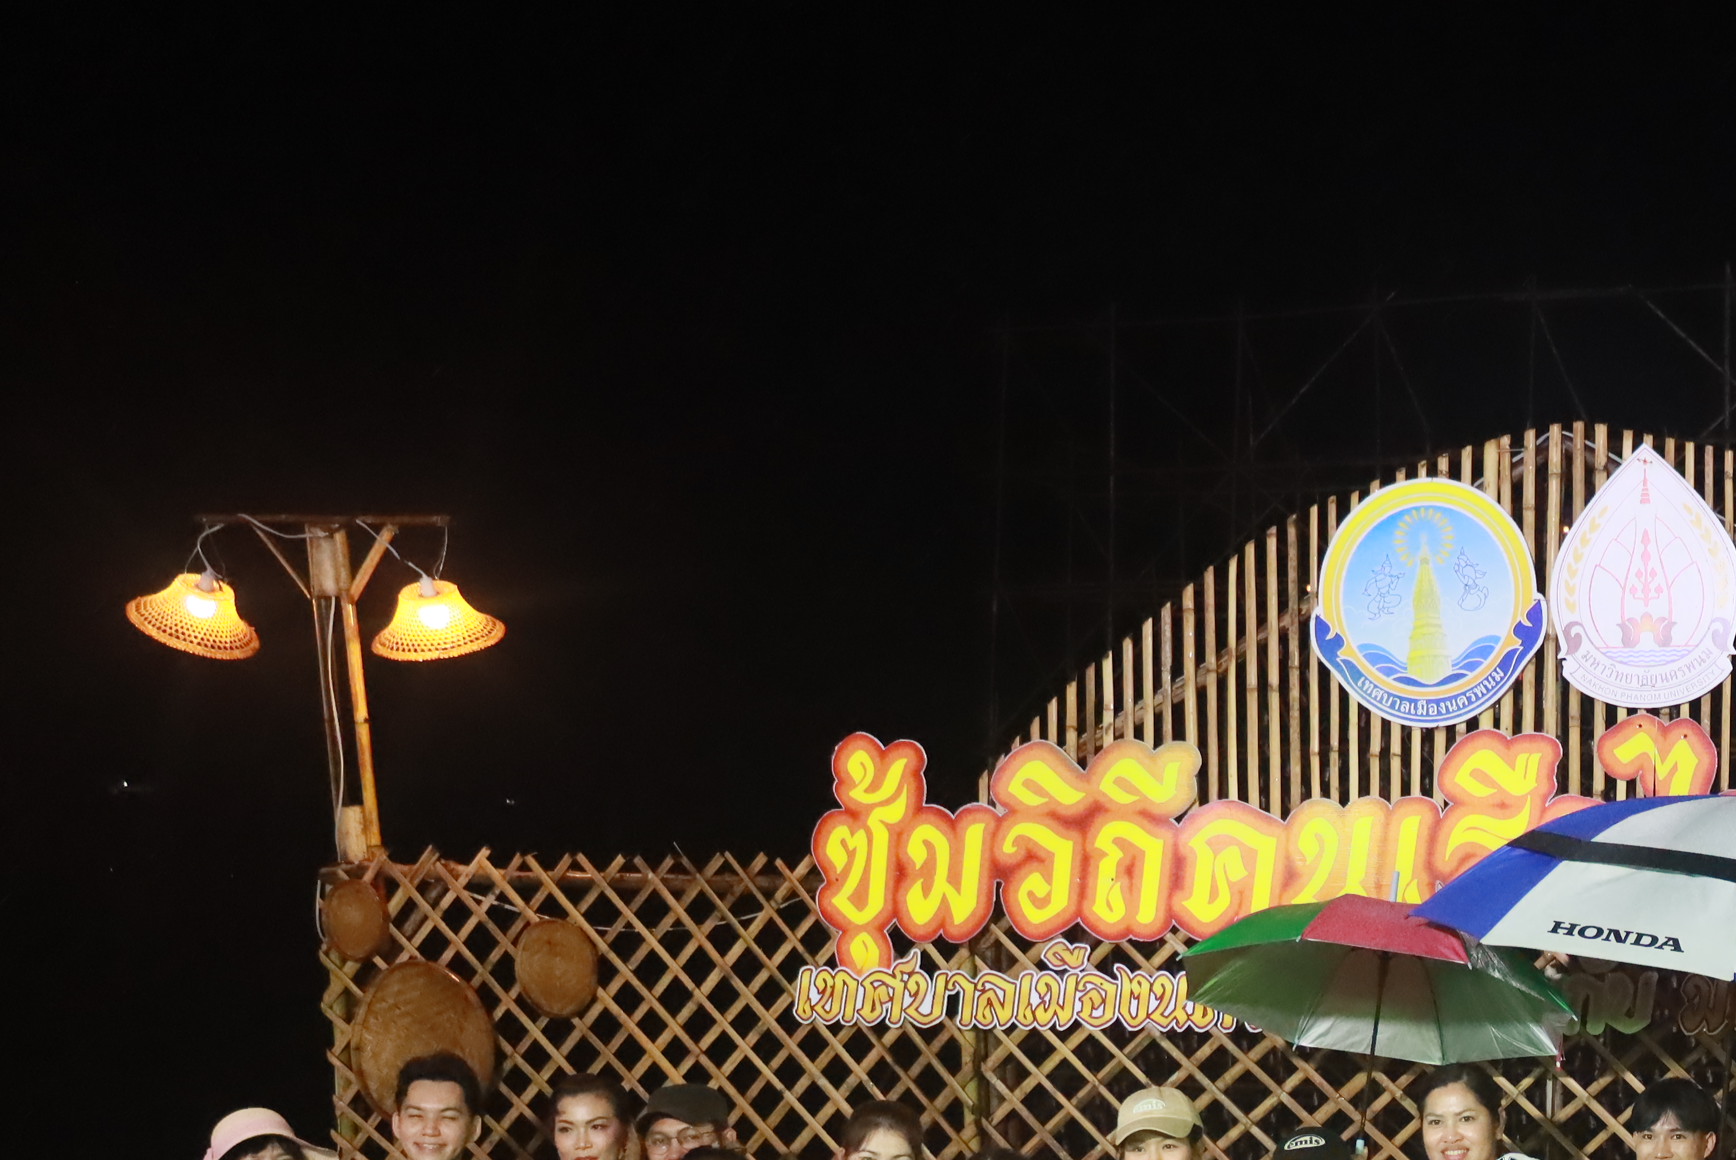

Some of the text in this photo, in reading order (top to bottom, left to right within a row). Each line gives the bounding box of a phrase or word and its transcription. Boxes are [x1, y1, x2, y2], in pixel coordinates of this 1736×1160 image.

[1580, 647, 1714, 687] มหาวิทยาลัยนครพนม
[1580, 668, 1717, 702] NAKHON PHANOM UNIVERSITY
[1357, 666, 1505, 716] เทศบาลเมืองนครพนม
[1547, 920, 1685, 953] HONDA
[795, 941, 1262, 1031] เทศบาลเมืองน
